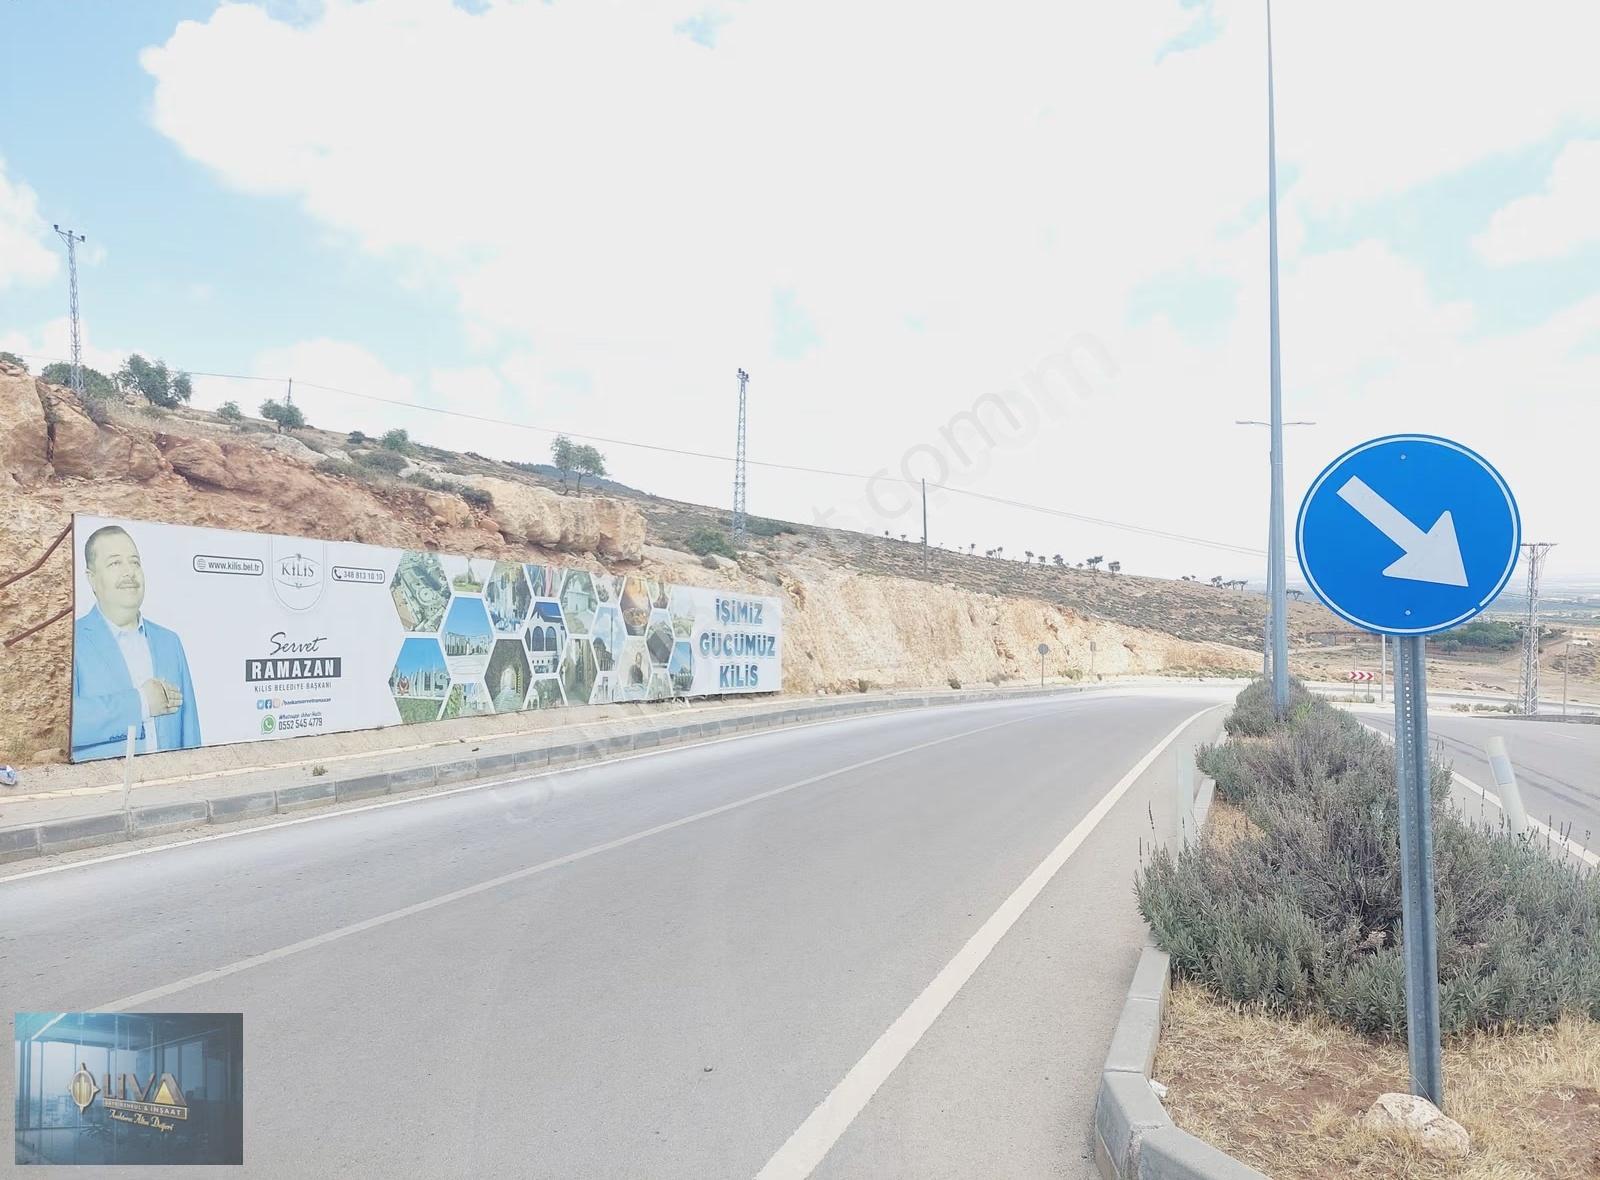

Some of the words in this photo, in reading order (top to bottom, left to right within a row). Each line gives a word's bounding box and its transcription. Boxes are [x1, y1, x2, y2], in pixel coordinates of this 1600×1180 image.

[208, 560, 260, 572] www.kilis.bel.tr
[715, 598, 763, 625] İŞİMİZ
[270, 631, 328, 656] Servet
[700, 631, 776, 657] GÜCÜMÜZ
[251, 659, 335, 680] RAMAZAN
[720, 664, 759, 688] KİLİS
[278, 720, 294, 731] 0552
[295, 718, 307, 729] 545
[308, 717, 323, 727] 4779
